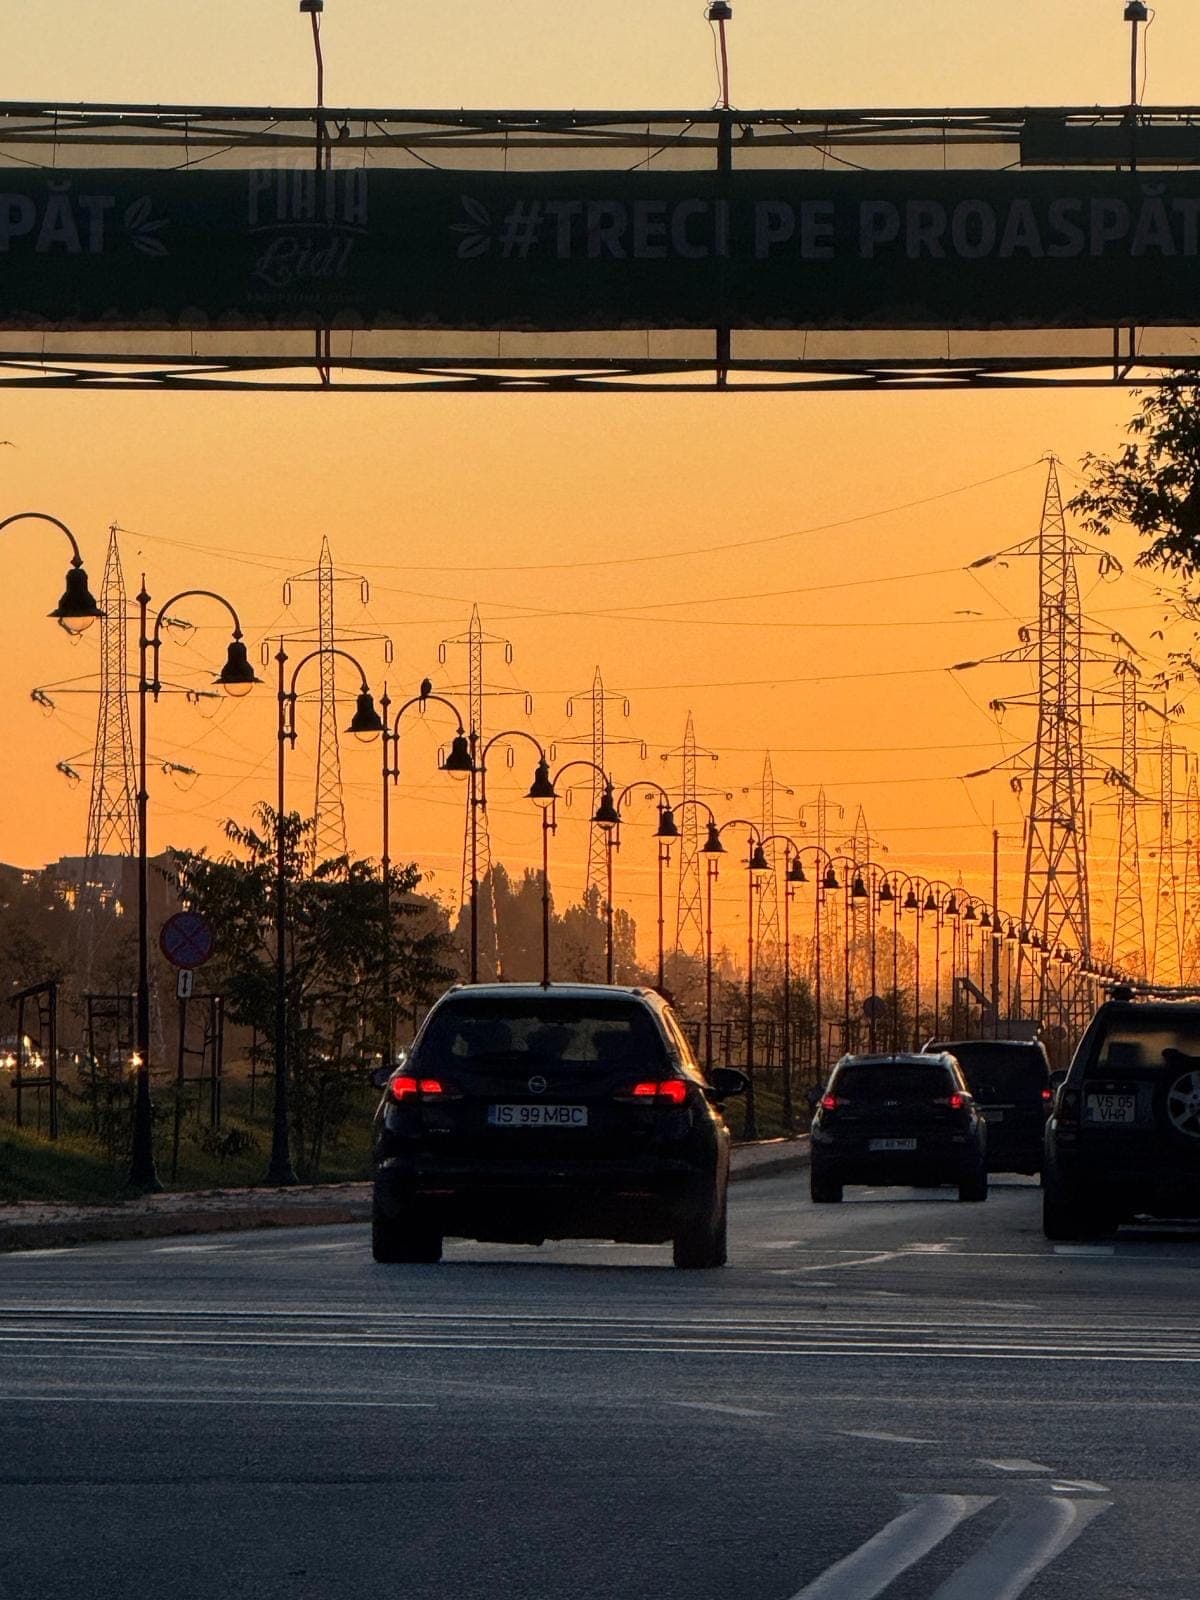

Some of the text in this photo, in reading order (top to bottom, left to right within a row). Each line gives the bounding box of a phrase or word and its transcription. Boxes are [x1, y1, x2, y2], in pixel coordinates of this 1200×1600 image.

[498, 183, 1200, 259] #TRECI PE PROASPĂT
[1096, 1095, 1114, 1108] VS
[497, 1106, 583, 1122] IS 99 MBC
